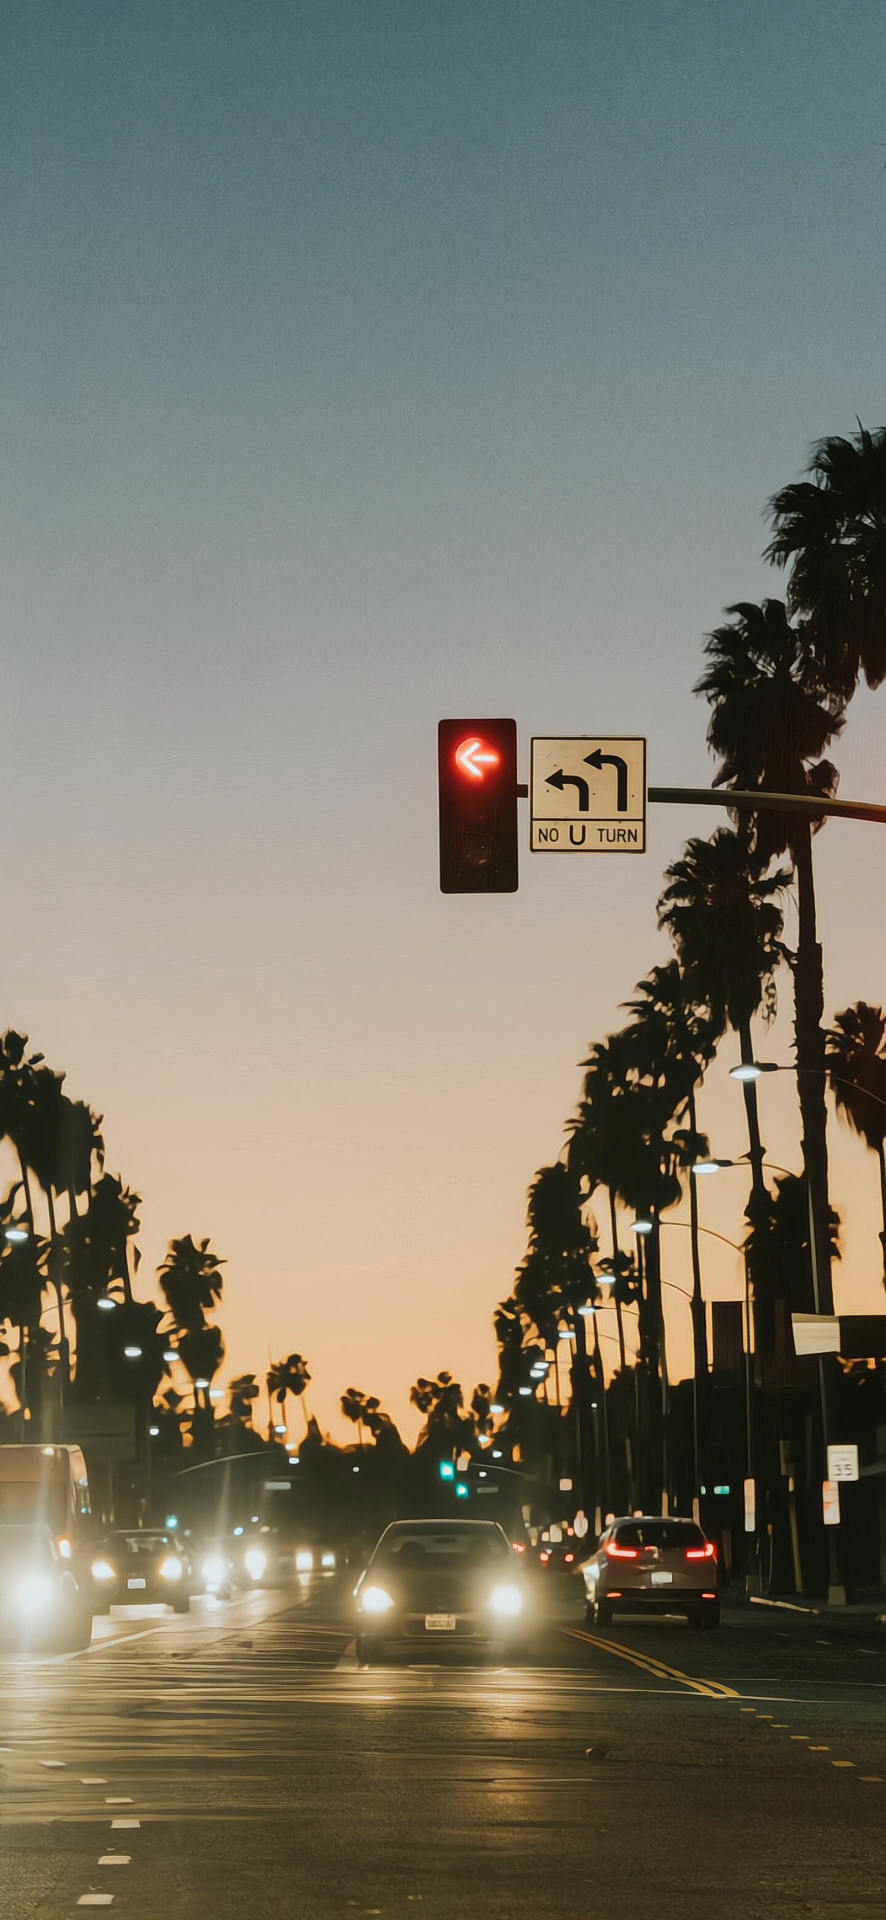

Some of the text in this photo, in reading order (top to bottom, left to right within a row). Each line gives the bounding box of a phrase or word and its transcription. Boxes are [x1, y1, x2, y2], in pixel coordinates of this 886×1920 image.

[538, 824, 638, 845] NO U TURN
[833, 1463, 852, 1476] 35
